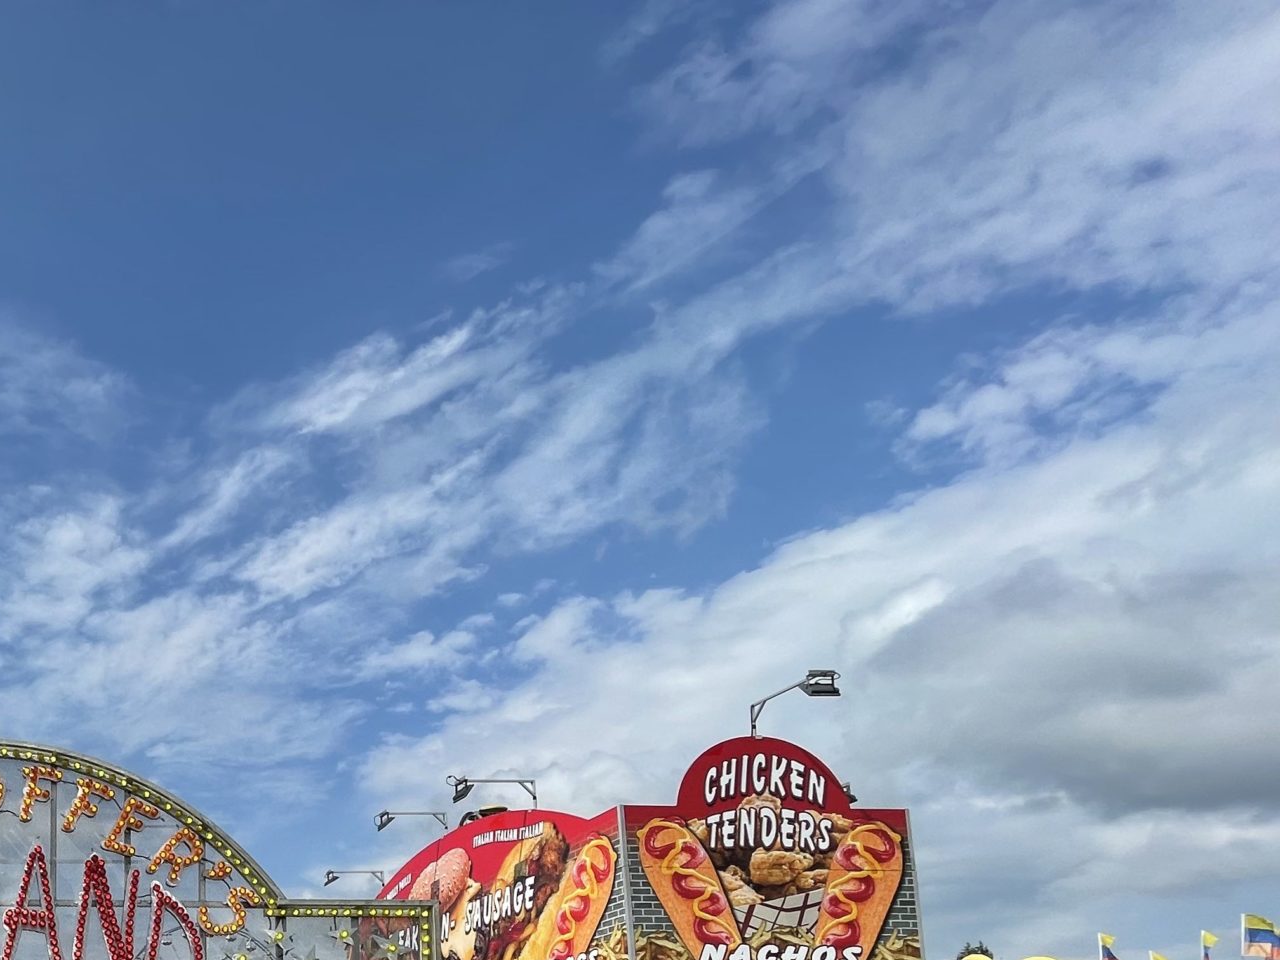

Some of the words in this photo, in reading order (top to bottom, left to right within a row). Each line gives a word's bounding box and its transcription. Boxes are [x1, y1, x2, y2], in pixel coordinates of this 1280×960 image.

[704, 753, 825, 806] CHICKEN
[472, 831, 494, 849] ITALIAN
[494, 829, 518, 842] ITALIAN
[519, 821, 544, 840] ITALIAN
[706, 808, 832, 850] TENDERS
[465, 876, 536, 935] SAUSAGE
